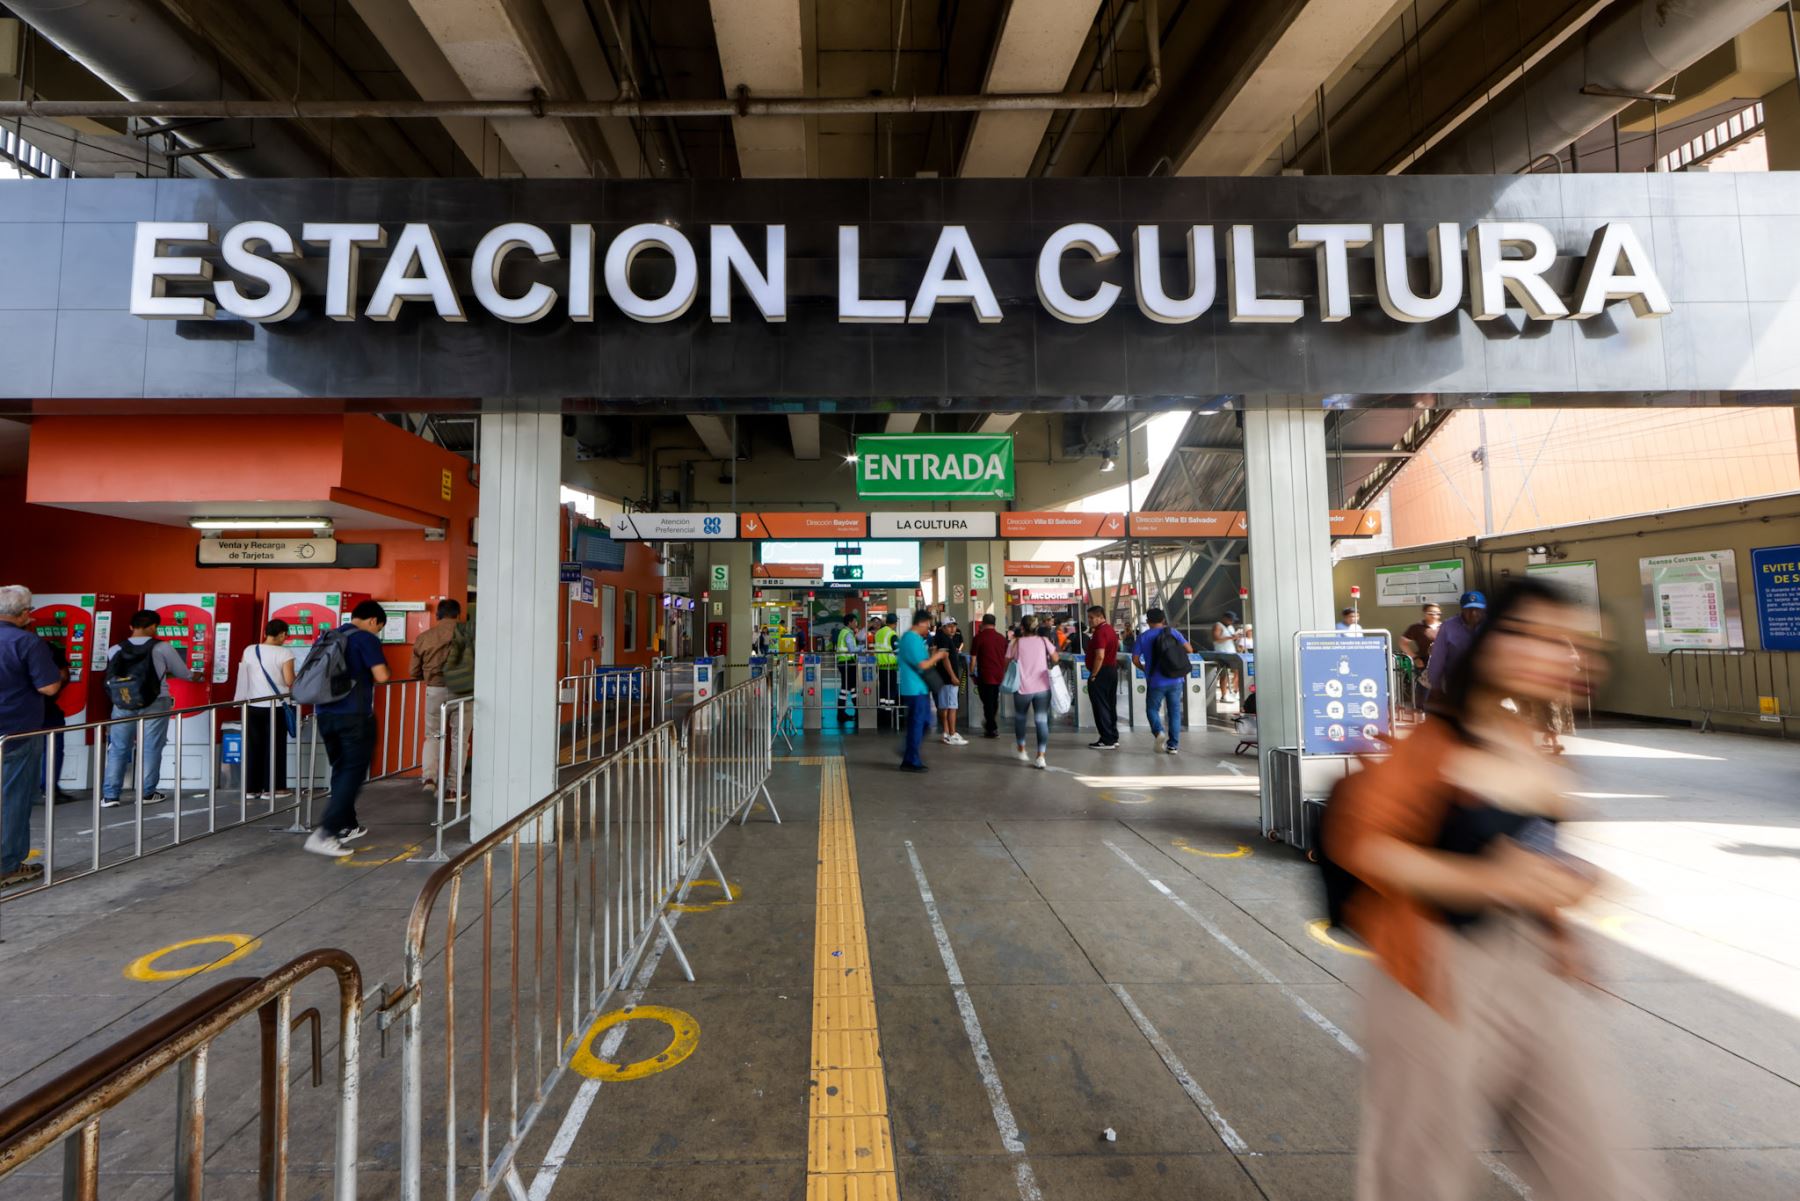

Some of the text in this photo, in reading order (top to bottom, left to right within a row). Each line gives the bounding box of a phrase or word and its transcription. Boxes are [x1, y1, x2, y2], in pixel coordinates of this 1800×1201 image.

[129, 220, 1673, 324] ESTACION LA CULTURA
[864, 453, 1006, 481] ENTRADA
[660, 517, 691, 525] Atención
[1055, 518, 1082, 526] Salvador
[1188, 516, 1217, 524] Salvador
[1329, 515, 1345, 523] ador
[655, 525, 696, 534] Preferencial
[896, 519, 968, 530] LA CULTURA
[218, 541, 286, 551] Venta y Recarga
[229, 551, 275, 560] de Tarjetas
[714, 567, 726, 580] S
[974, 565, 985, 579] S
[1762, 563, 1795, 574] EVITE
[1774, 573, 1800, 583] DE S
